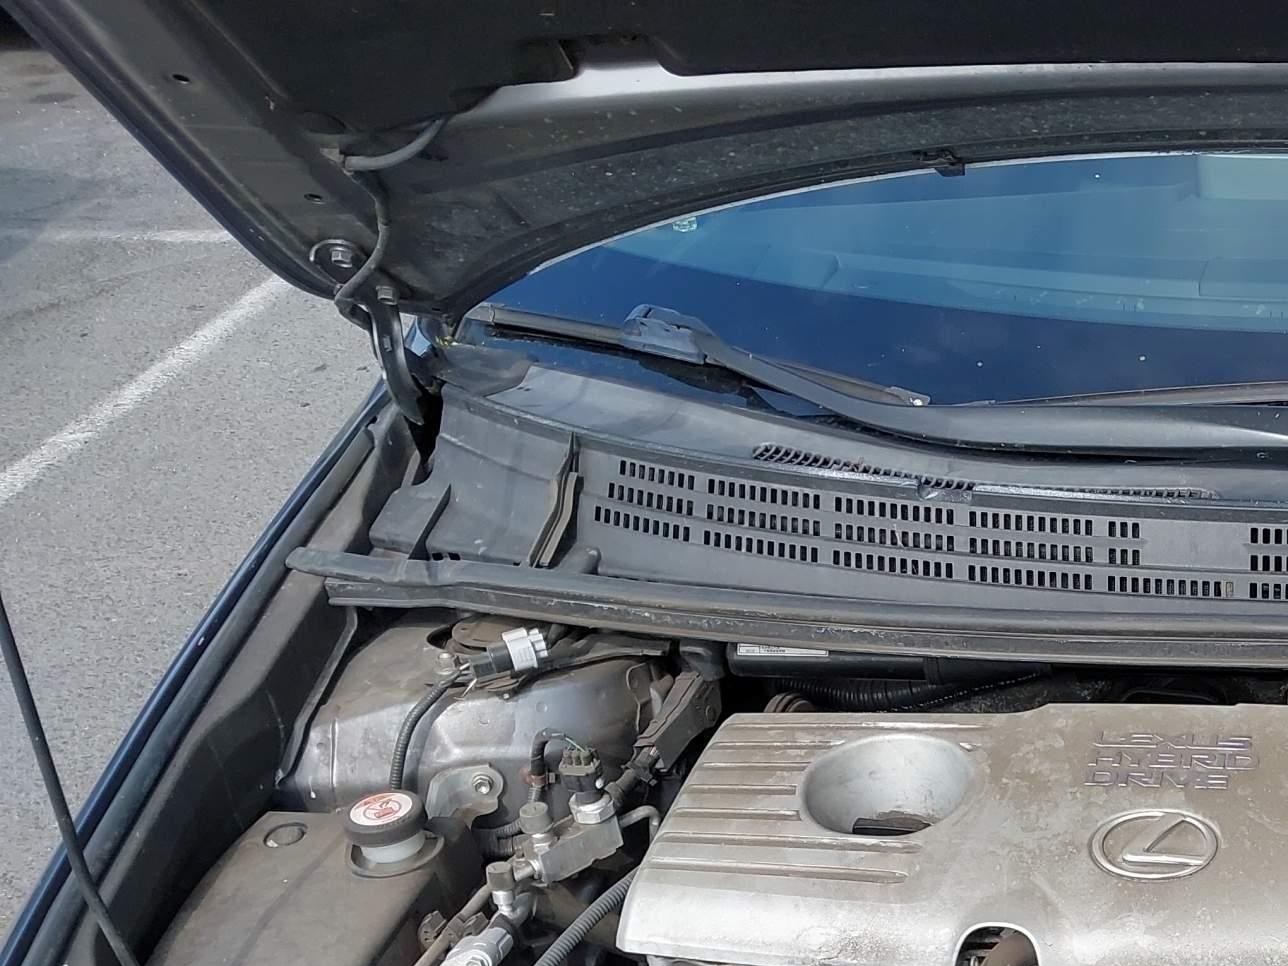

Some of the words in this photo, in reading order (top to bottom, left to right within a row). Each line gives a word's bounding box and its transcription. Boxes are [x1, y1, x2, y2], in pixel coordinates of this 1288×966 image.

[1092, 730, 1252, 751] LEXUS
[1088, 750, 1260, 770] HYBRID
[1084, 768, 1230, 790] DRIVE
